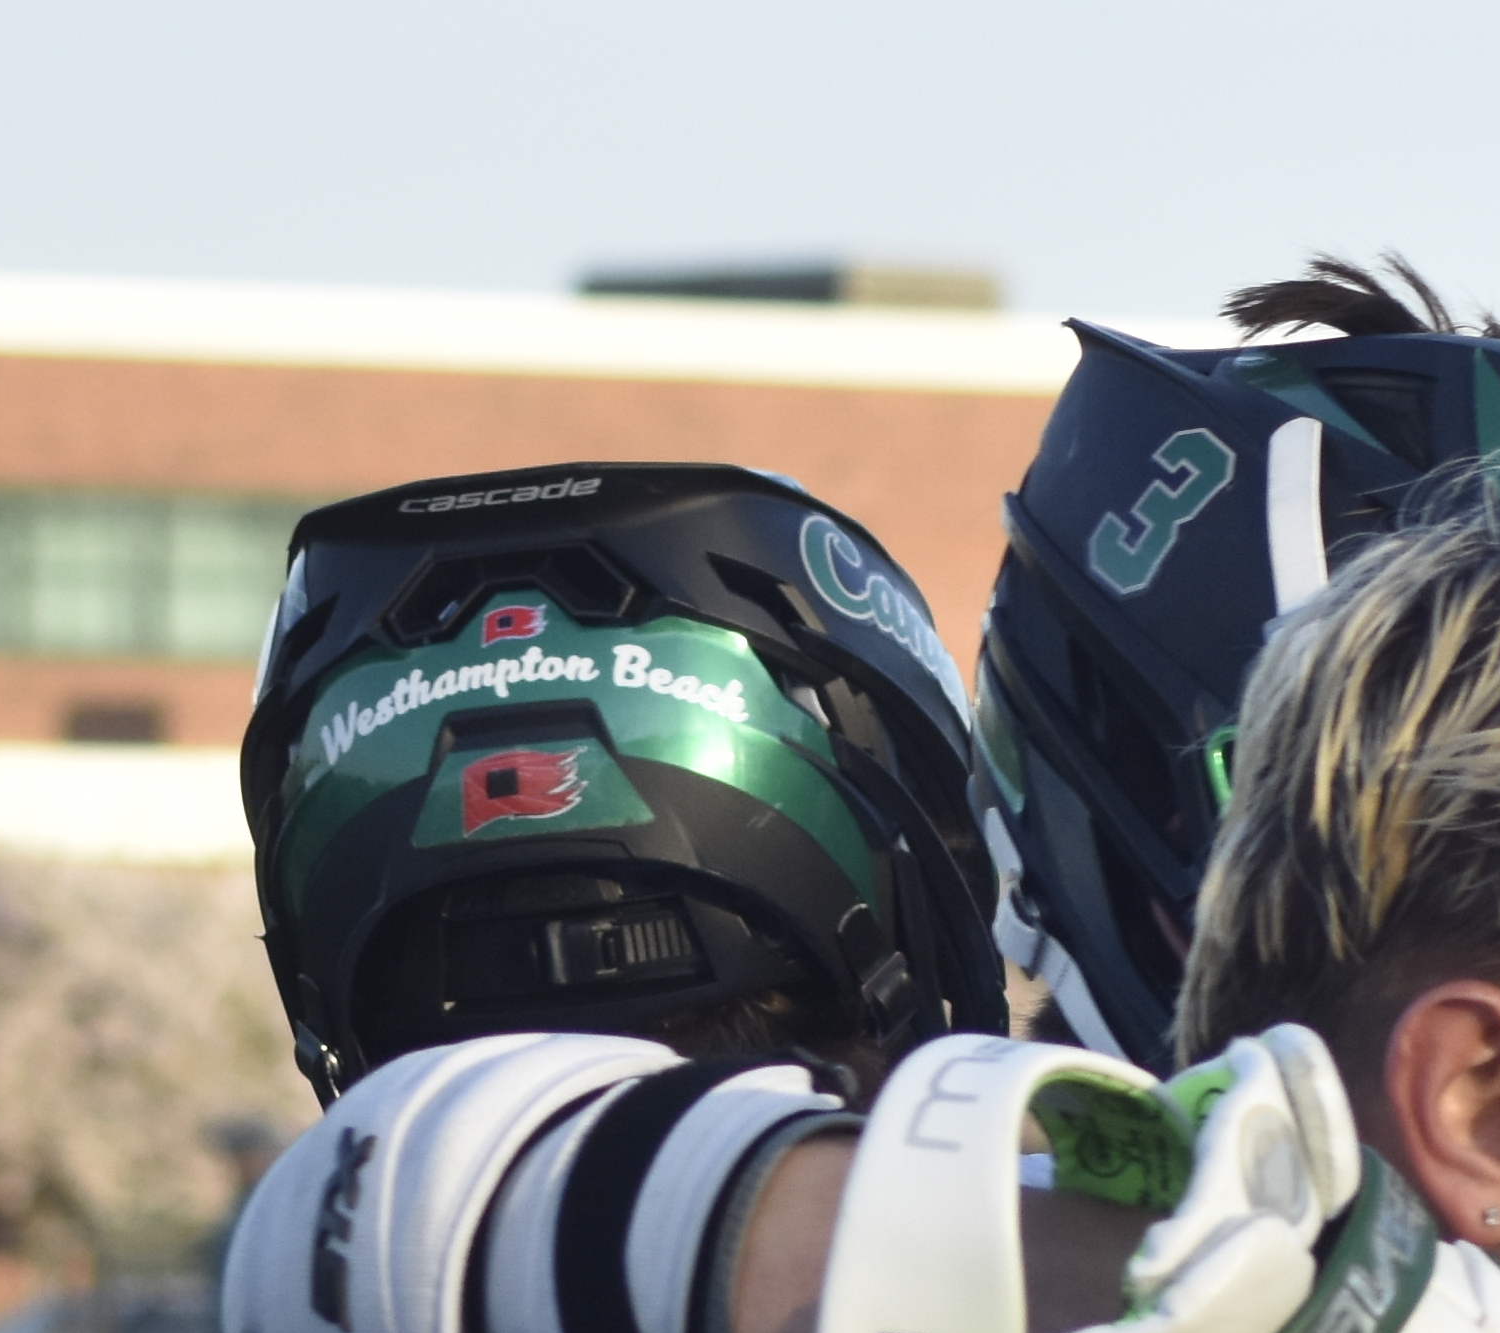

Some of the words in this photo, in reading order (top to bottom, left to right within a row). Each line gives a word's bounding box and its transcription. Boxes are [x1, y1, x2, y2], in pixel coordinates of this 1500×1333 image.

[398, 477, 602, 513] cascade
[1088, 427, 1237, 595] 3
[319, 645, 600, 766] Westhampton
[611, 643, 750, 723] Beach
